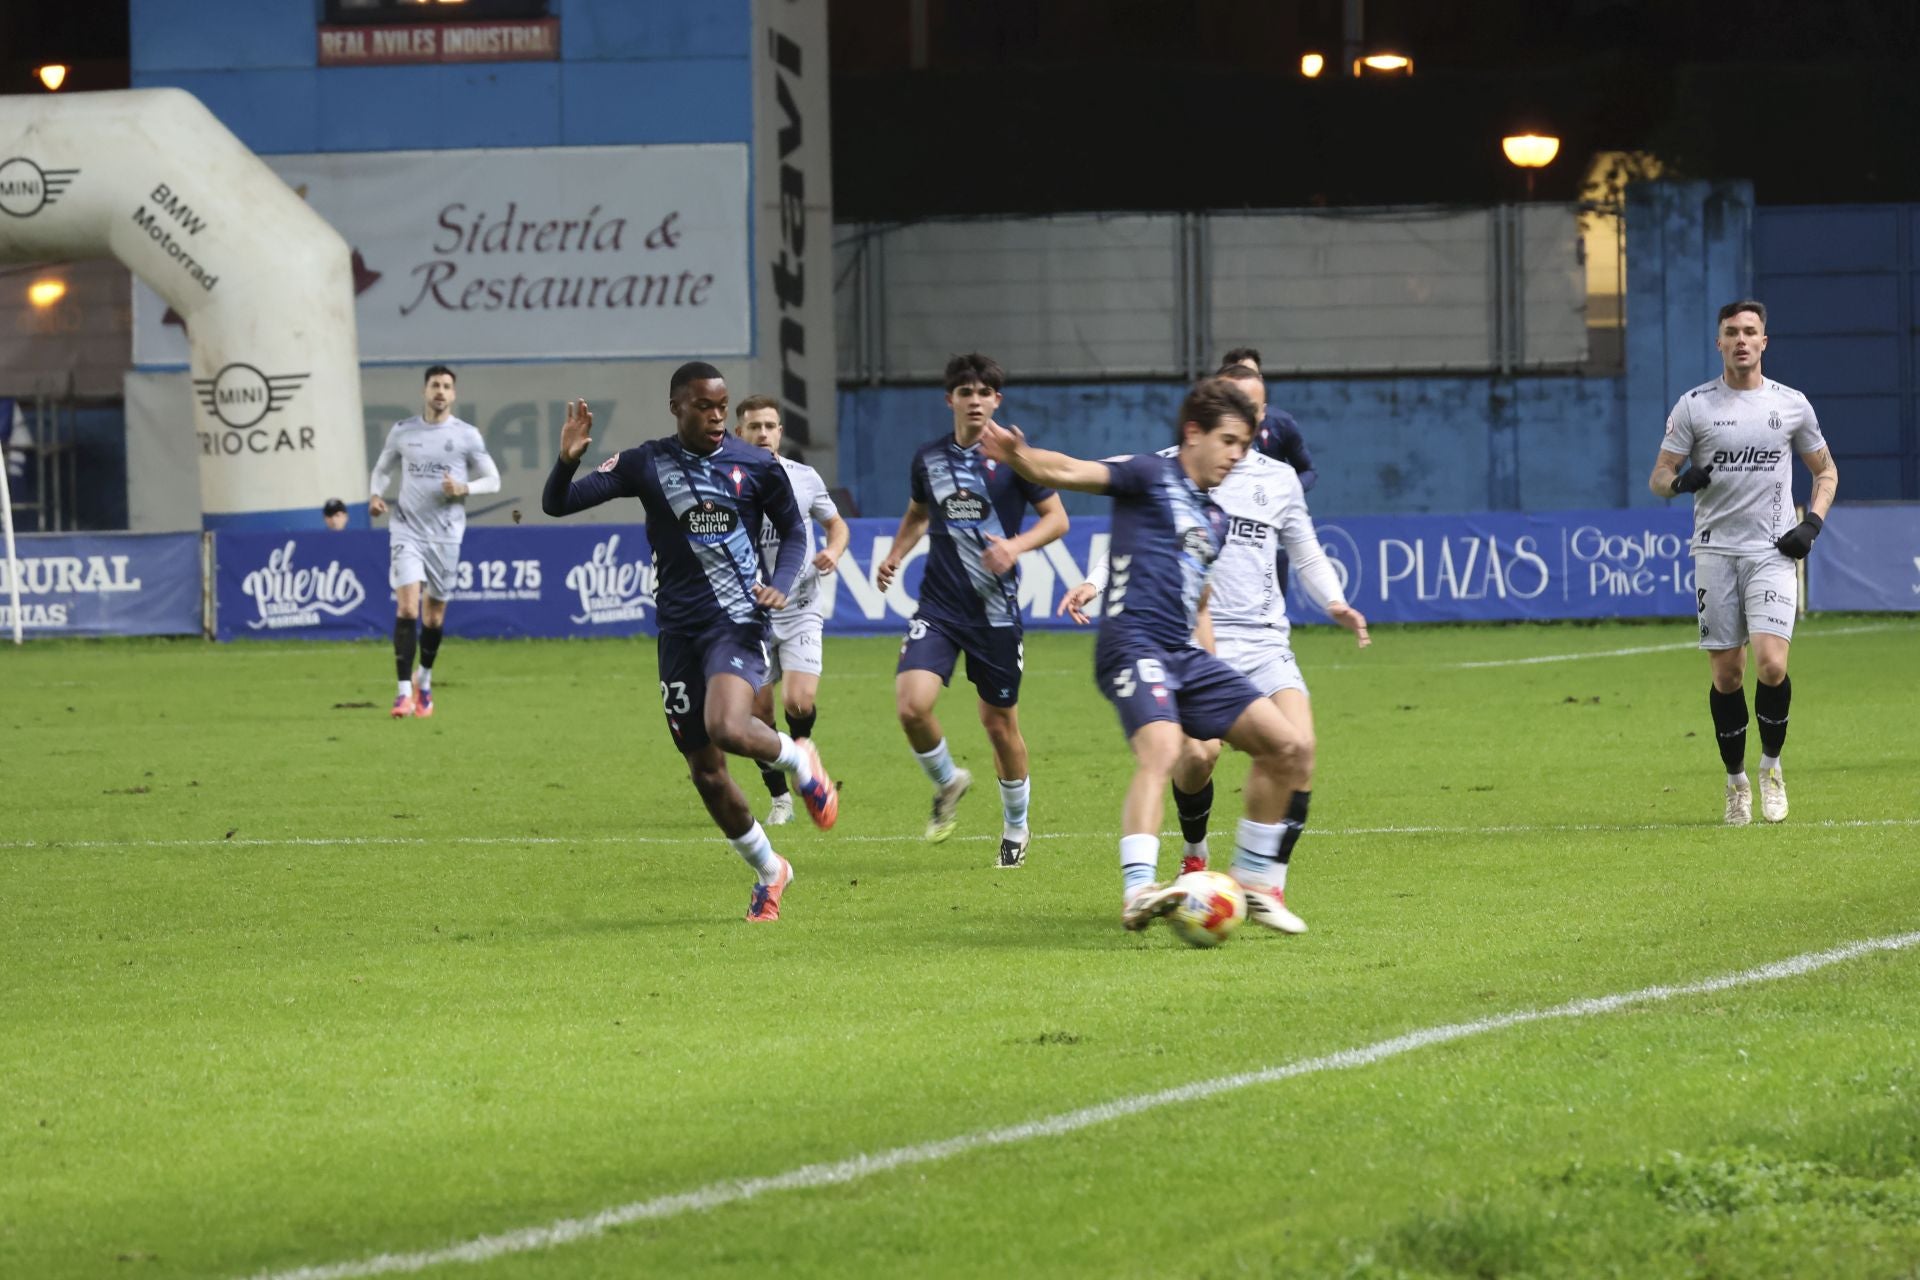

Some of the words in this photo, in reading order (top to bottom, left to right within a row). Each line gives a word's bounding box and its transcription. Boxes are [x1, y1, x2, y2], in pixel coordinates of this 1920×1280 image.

[321, 31, 366, 58] REAL
[371, 29, 436, 55] AVILES
[443, 26, 551, 54] INDUSTRIAL
[0, 180, 40, 196] MINI
[150, 184, 207, 236] BMW
[432, 203, 627, 255] Sidrería
[644, 211, 681, 250] &
[131, 205, 219, 292] Motorrad
[400, 260, 715, 316] Restaurante
[219, 387, 263, 404] MINI
[1713, 446, 1781, 465] avilés
[688, 511, 730, 522] Estrella
[1772, 481, 1783, 529] TRIOCAR
[690, 522, 728, 533] Galicia
[478, 561, 507, 589] 12
[512, 560, 542, 589] 75
[1379, 534, 1549, 601] PLAZAS
[660, 680, 690, 714] 23
